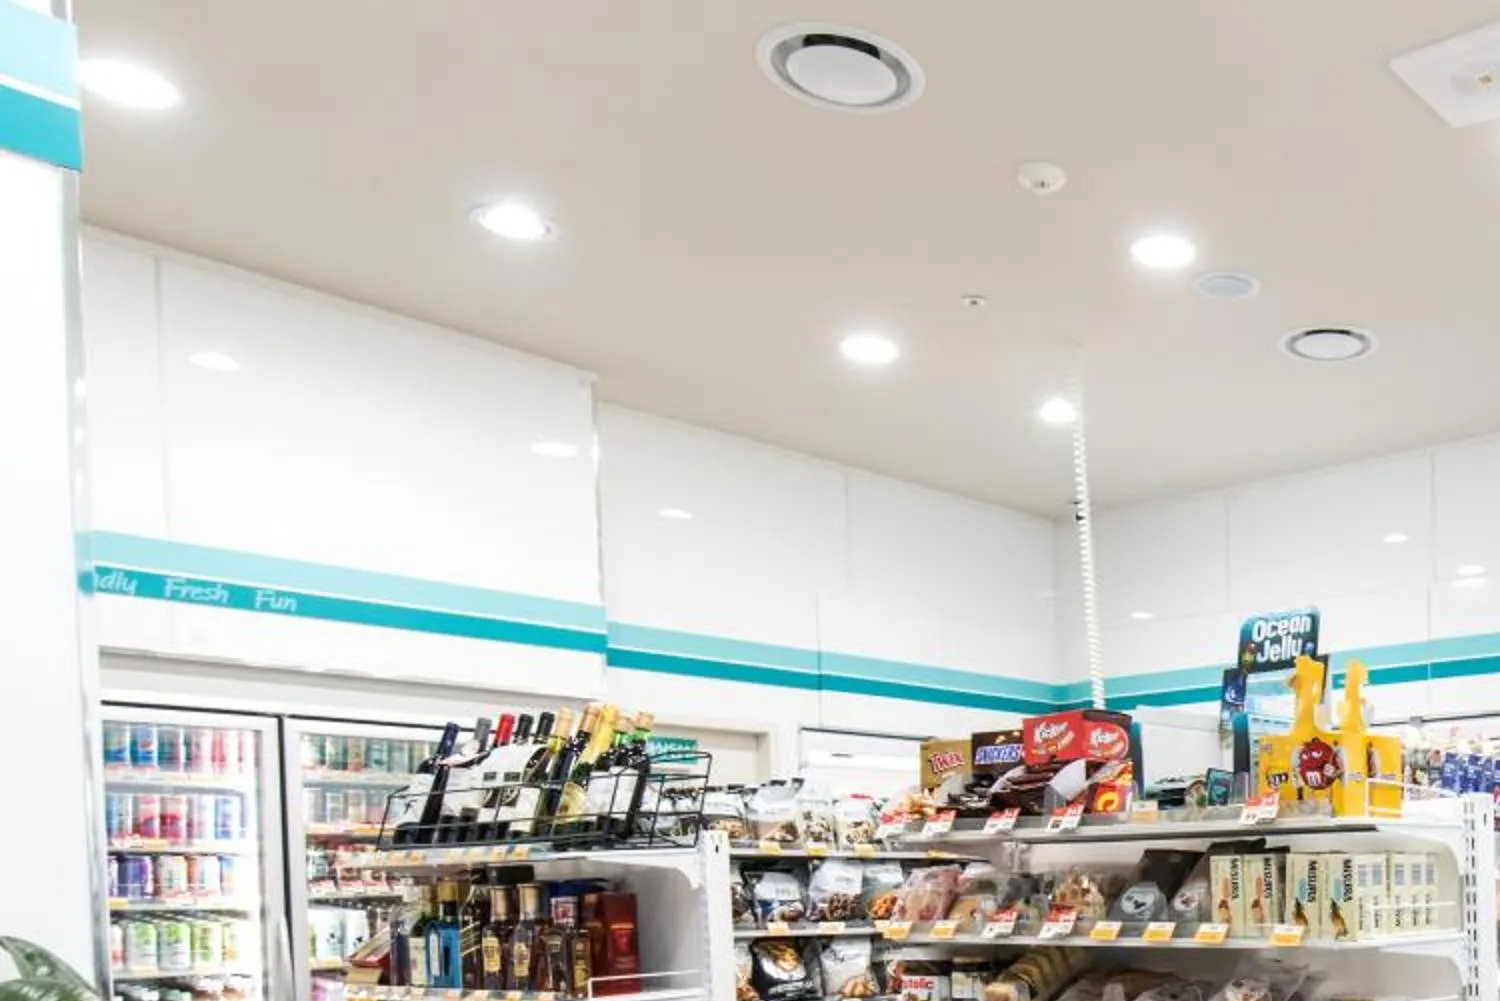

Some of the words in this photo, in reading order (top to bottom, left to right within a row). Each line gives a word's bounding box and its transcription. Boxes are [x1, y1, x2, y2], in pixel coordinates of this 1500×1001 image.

[164, 577, 230, 605] Fresh
[254, 589, 298, 612] Fun
[1252, 615, 1312, 643] Ocean
[1256, 639, 1303, 664] Jelly
